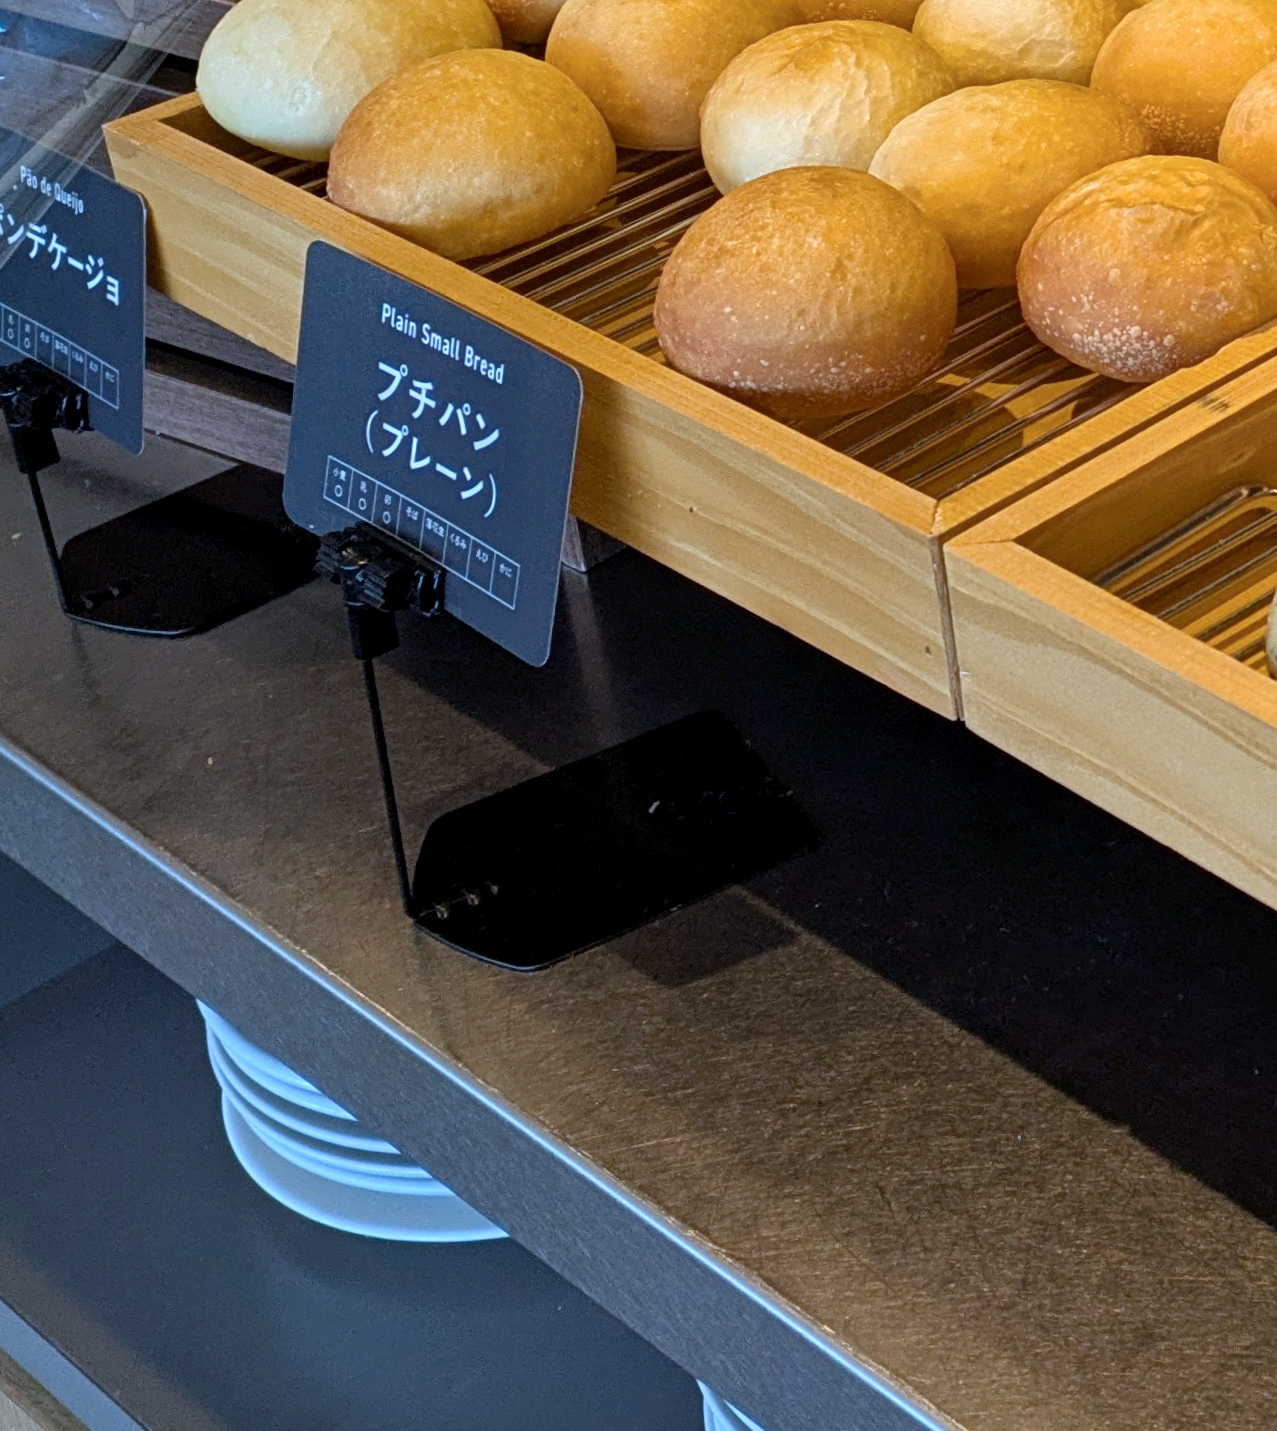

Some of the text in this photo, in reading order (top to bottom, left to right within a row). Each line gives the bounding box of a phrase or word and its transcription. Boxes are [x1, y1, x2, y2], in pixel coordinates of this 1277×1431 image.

[20, 165, 84, 215] Pão de Queijo
[0, 204, 121, 307] ンデケージョ
[381, 303, 504, 385] Plain Small Bread
[377, 361, 500, 451] プチパン
